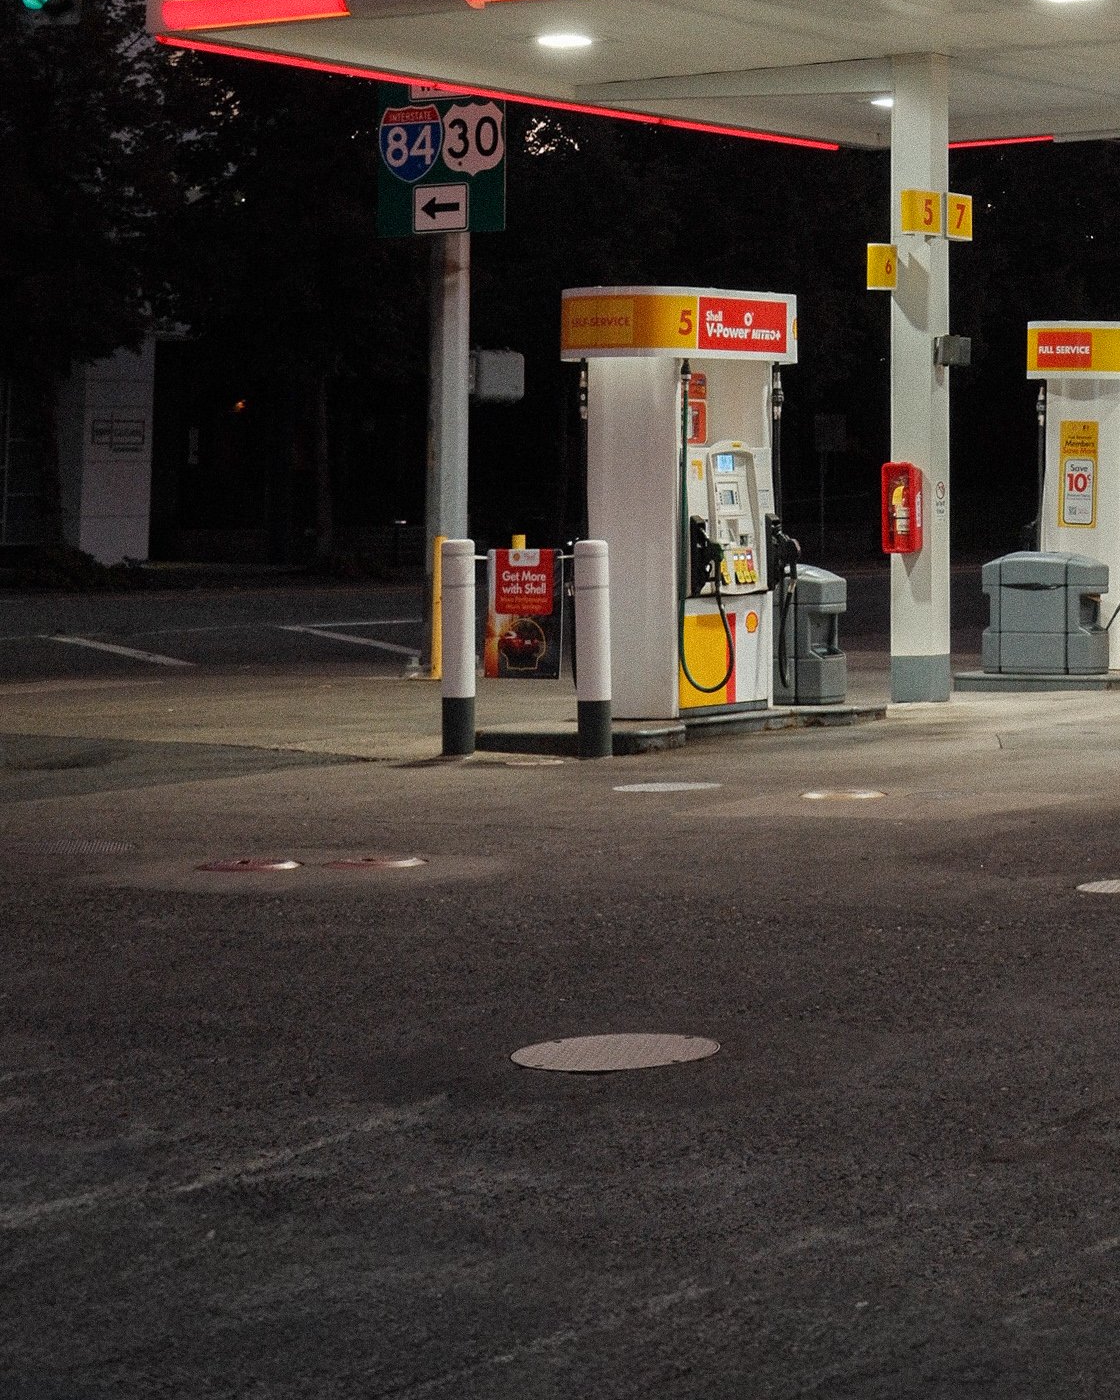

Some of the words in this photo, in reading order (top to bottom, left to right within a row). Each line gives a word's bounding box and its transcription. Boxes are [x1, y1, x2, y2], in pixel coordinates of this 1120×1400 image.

[389, 110, 432, 122] INTERSTATE
[448, 115, 498, 159] 30
[386, 124, 434, 168] 84
[923, 198, 933, 226] 5
[956, 203, 966, 229] 7
[885, 260, 892, 275] 6
[678, 309, 693, 336] 5
[705, 309, 723, 322] Shell
[705, 321, 749, 339] V-Power
[1038, 345, 1054, 355] FULL
[1056, 345, 1090, 355] SERVICE
[1070, 463, 1088, 472] Save
[502, 570, 520, 581] Get
[521, 570, 547, 582] More
[502, 583, 522, 594] with
[524, 583, 546, 594] Shell
